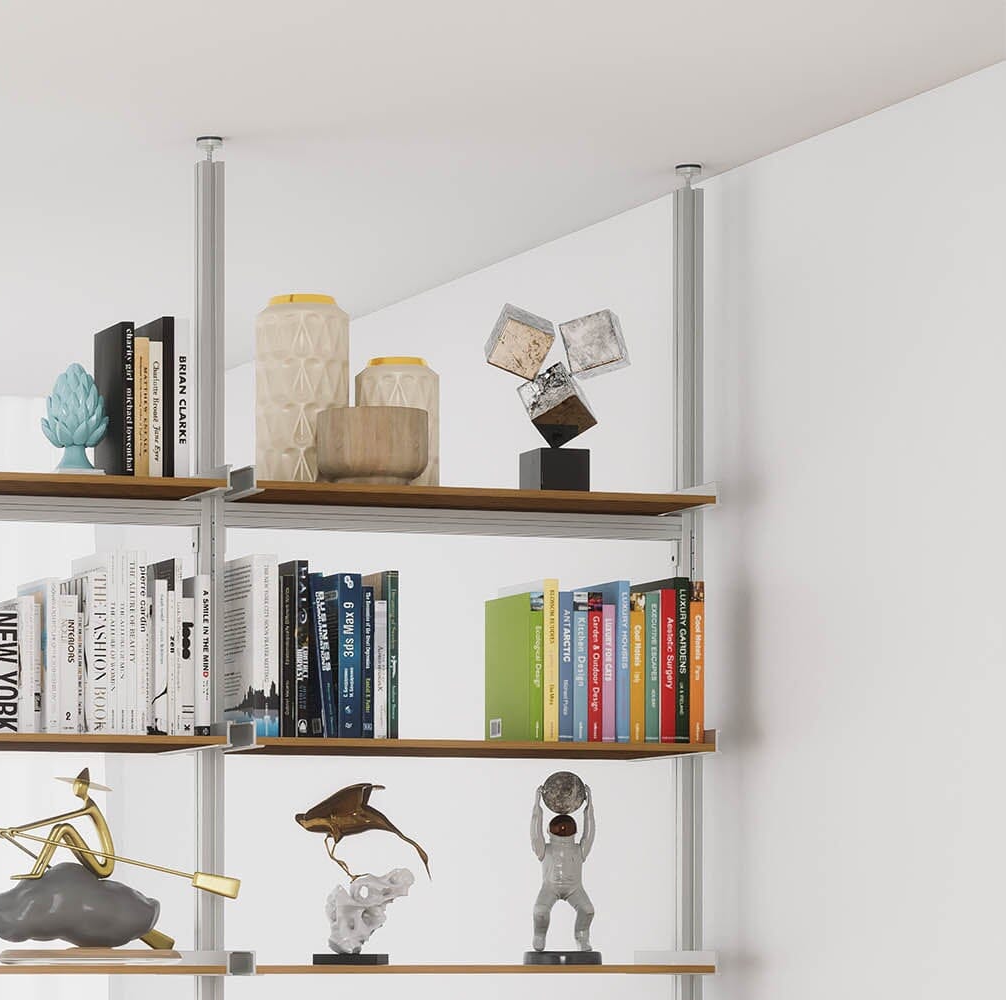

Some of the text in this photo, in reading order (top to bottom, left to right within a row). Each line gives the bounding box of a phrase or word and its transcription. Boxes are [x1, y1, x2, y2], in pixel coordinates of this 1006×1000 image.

[124, 328, 134, 381] charity girl
[178, 356, 187, 445] BRIAN CLARKE
[125, 387, 134, 472] michael lowenthal
[152, 423, 161, 462] Jane Eyre
[139, 566, 147, 633] pierre cardin
[67, 619, 75, 664] INTERIORS
[93, 574, 107, 731] THE FASHION BOOK
[203, 626, 210, 635] IN
[318, 591, 332, 672] BUSINESS
[344, 601, 354, 658] 3ds Max 9
[563, 609, 571, 662] ANTARCTIC
[576, 617, 586, 687] Kitchen Design
[592, 616, 600, 643] Garden
[633, 624, 642, 667] Cool Hotels
[650, 603, 658, 681] EXECUTIVE ESCAPES
[679, 588, 687, 674] LUXURY GARDENS
[694, 614, 702, 660] Cool Hotels
[592, 652, 600, 685] Outdoor
[590, 687, 600, 712] Design
